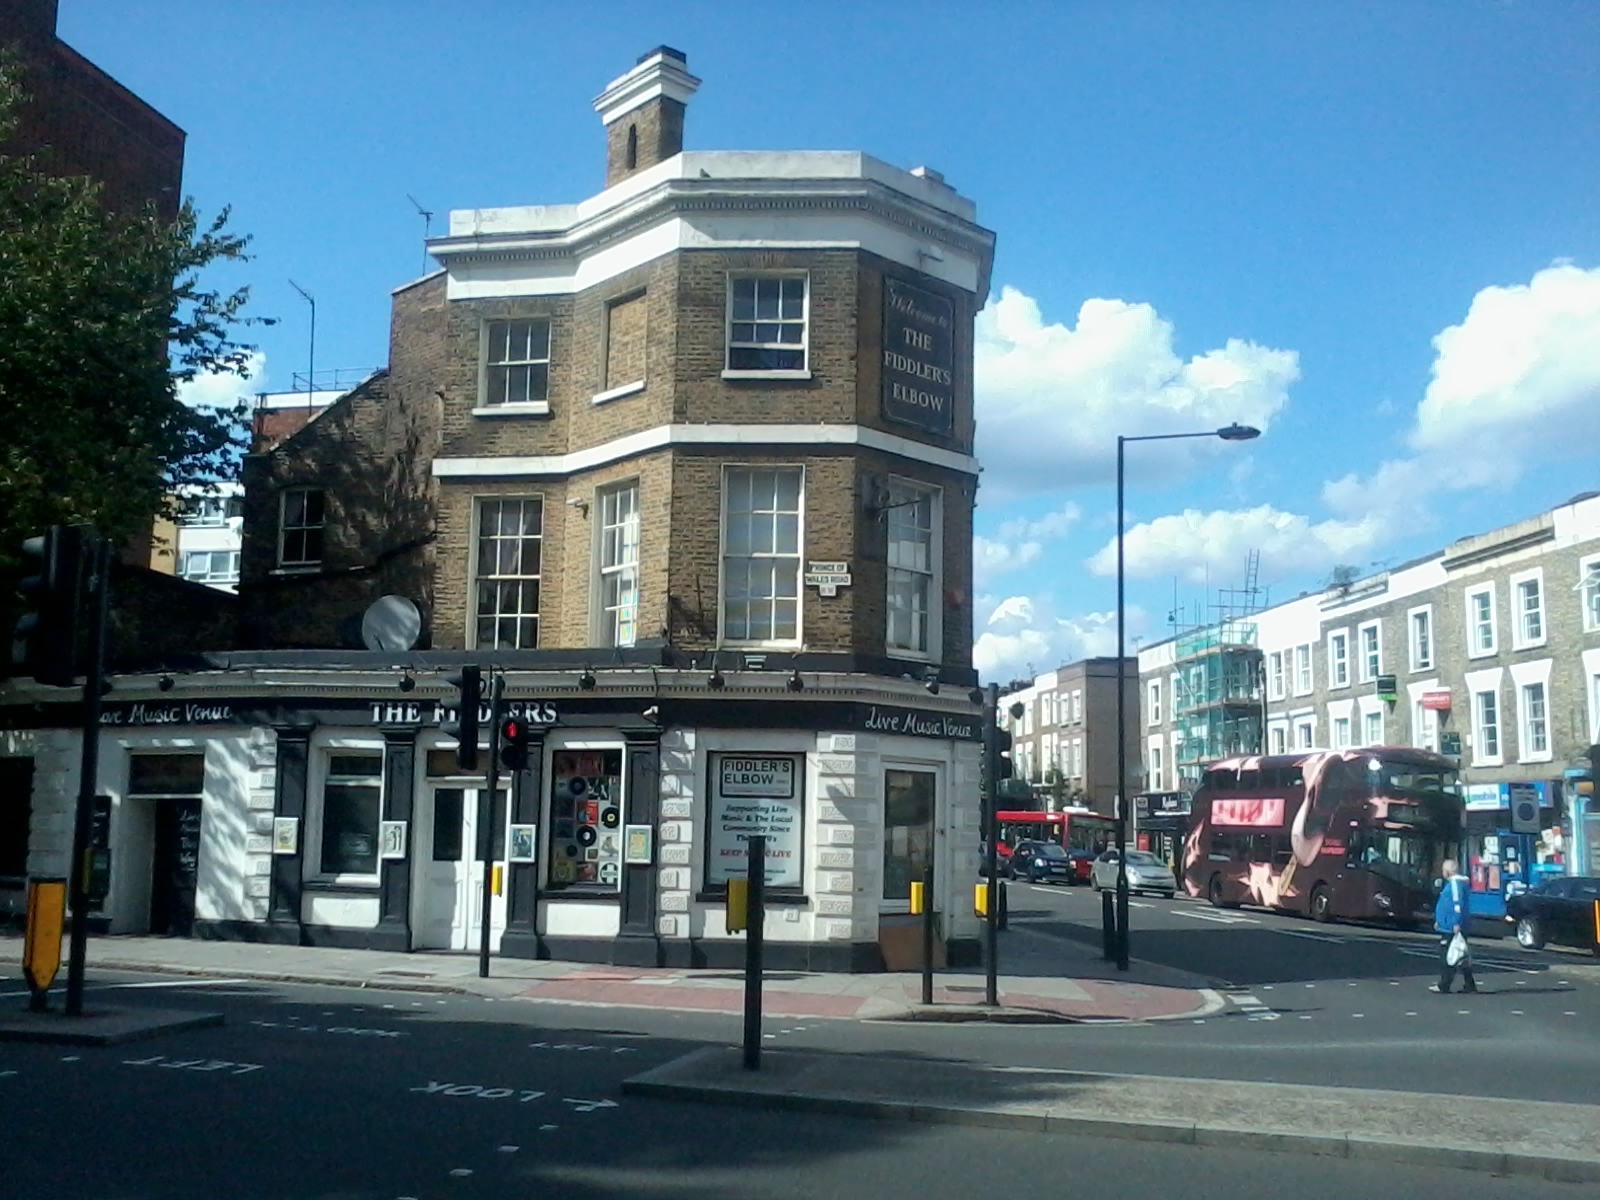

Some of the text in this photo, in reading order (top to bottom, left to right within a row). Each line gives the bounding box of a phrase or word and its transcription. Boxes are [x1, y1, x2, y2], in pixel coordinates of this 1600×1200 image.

[903, 327, 932, 351] THE
[884, 350, 951, 385] FIDDLER'S
[893, 382, 943, 411] ELBOW
[128, 703, 181, 724] Music
[185, 703, 234, 722] Venue
[370, 702, 421, 722] THE
[865, 706, 971, 737] Live Music Venue
[724, 761, 790, 773] FIDDLER'S
[724, 773, 774, 784] ELBOW
[726, 805, 788, 814] Supporting Live
[746, 814, 752, 822] &
[755, 814, 769, 822] The
[771, 815, 793, 823] Local
[772, 850, 792, 858] LIVE
[410, 1081, 546, 1102] LOOK
